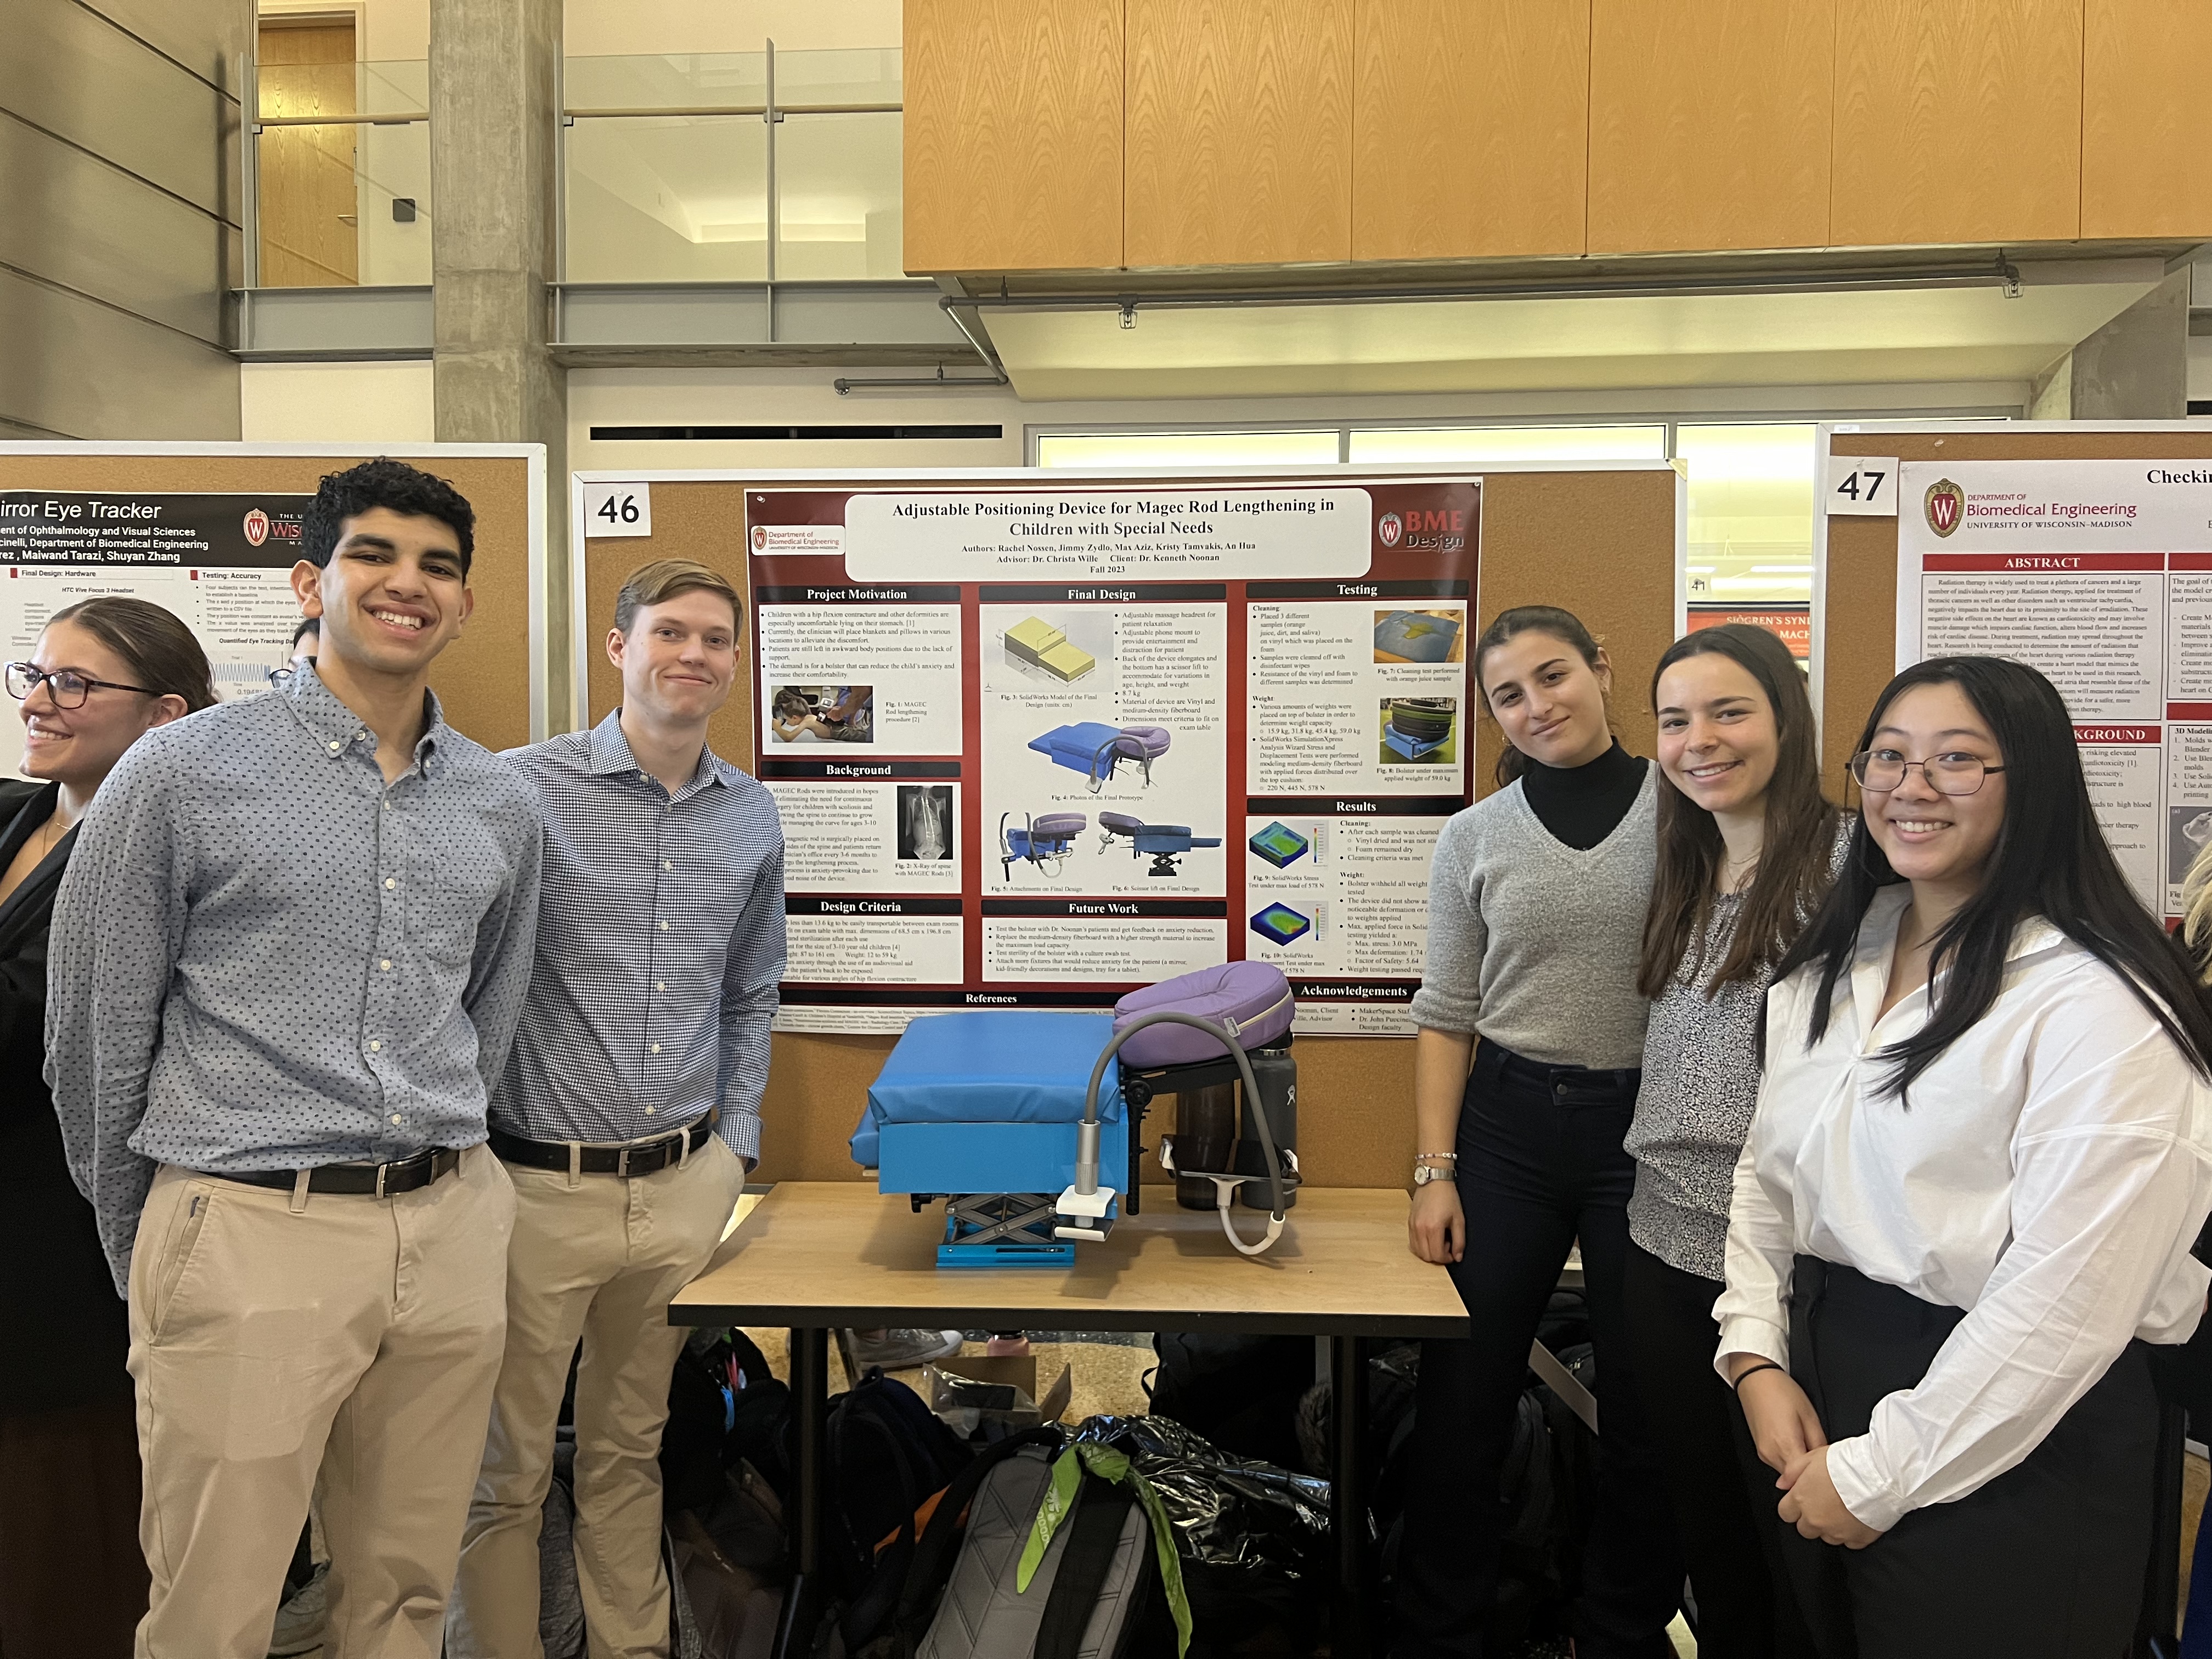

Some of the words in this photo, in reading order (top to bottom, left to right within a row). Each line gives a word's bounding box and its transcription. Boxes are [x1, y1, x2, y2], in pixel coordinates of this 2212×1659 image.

[1837, 472, 1885, 500] 47
[1, 500, 38, 517] irror
[45, 501, 81, 521] Eye
[88, 502, 161, 518] Tracker
[598, 495, 639, 523] 46
[893, 504, 969, 519] Adjustable
[975, 503, 1053, 518] Positioning
[1060, 503, 1105, 514] Device
[1111, 502, 1131, 514] for
[1137, 502, 1183, 516] Magec
[1189, 501, 1217, 512] Rod
[1224, 499, 1315, 515] Lengthening
[1321, 499, 1333, 510] in
[1967, 504, 2045, 516] Biomedical
[2052, 504, 2136, 518] Engineering
[1406, 510, 1464, 531] BME
[18, 526, 27, 534] of
[30, 526, 99, 537] Ophthalmology
[102, 527, 119, 535] and
[122, 527, 150, 535] Visual
[154, 527, 195, 536] Sciences
[1010, 523, 1072, 535] Children
[1079, 523, 1108, 534] with
[1114, 522, 1164, 538] Special
[1171, 521, 1212, 533] Needs
[0, 538, 27, 548] cinelli,
[30, 538, 84, 548] Department
[87, 539, 96, 547] of
[99, 539, 150, 548] Biomedical
[154, 540, 208, 550] Engineering
[1407, 534, 1464, 553] Design
[22, 550, 67, 560] Maiwand
[70, 551, 104, 561] Tarazi,
[107, 551, 144, 562] Shuyan
[148, 551, 180, 563] Zhang
[2005, 558, 2080, 568] ABSTRACT
[808, 590, 845, 601] Project
[849, 589, 906, 599] Motivation
[1069, 590, 1095, 599] Final
[1101, 589, 1135, 601] Design
[1337, 585, 1377, 596] Testing
[2074, 730, 2145, 740] KGROUND
[827, 765, 890, 777] Background
[1337, 802, 1376, 811] Results
[821, 902, 855, 913] Design
[859, 902, 901, 911] Criteria
[1069, 904, 1104, 913] Future
[1108, 904, 1138, 913] Work
[1301, 986, 1407, 997] Acknowledgements
[967, 994, 1017, 1002] References
